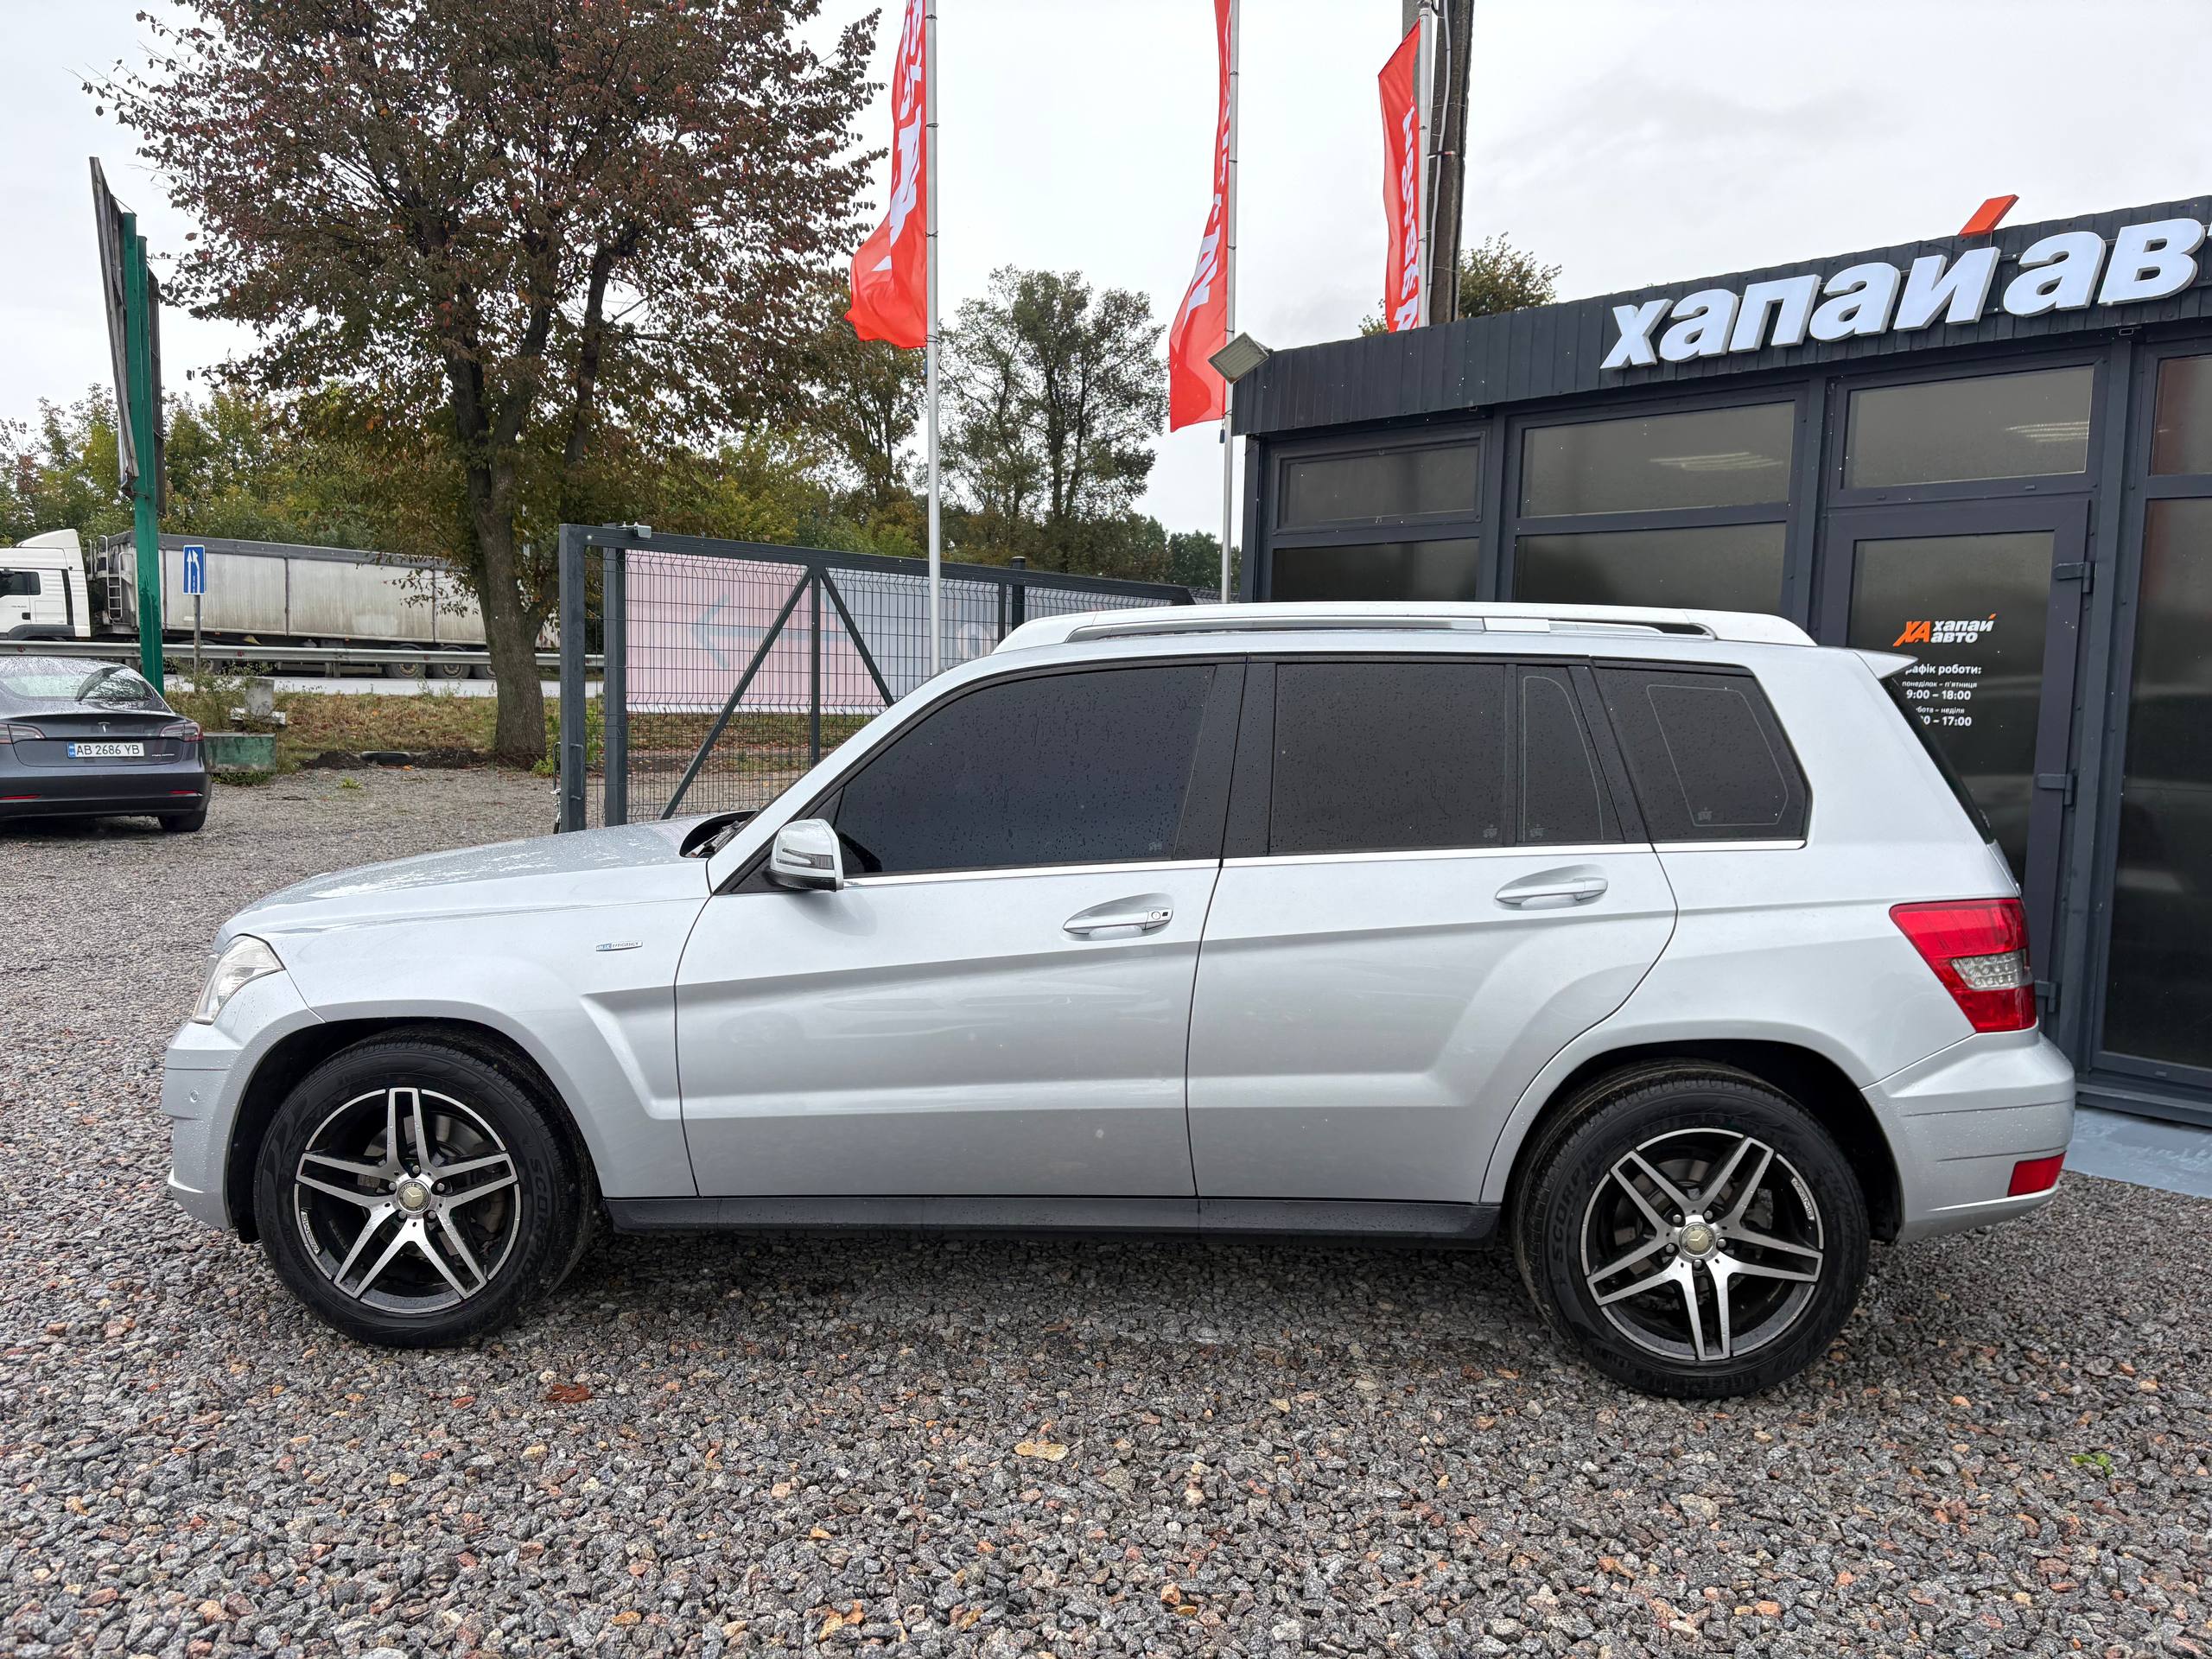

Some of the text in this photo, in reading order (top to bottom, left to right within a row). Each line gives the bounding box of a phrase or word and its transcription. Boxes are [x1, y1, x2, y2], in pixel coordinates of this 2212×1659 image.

[1600, 194, 2212, 369] хапай ав
[1931, 613, 1997, 632] хапай
[1930, 632, 1979, 644] авто
[1938, 664, 1982, 676] роботи:
[1906, 689, 1930, 699] 9:00
[1942, 690, 1972, 701] 18:00
[1942, 716, 1972, 727] 17:00
[76, 744, 140, 755] AB 2686 YB
